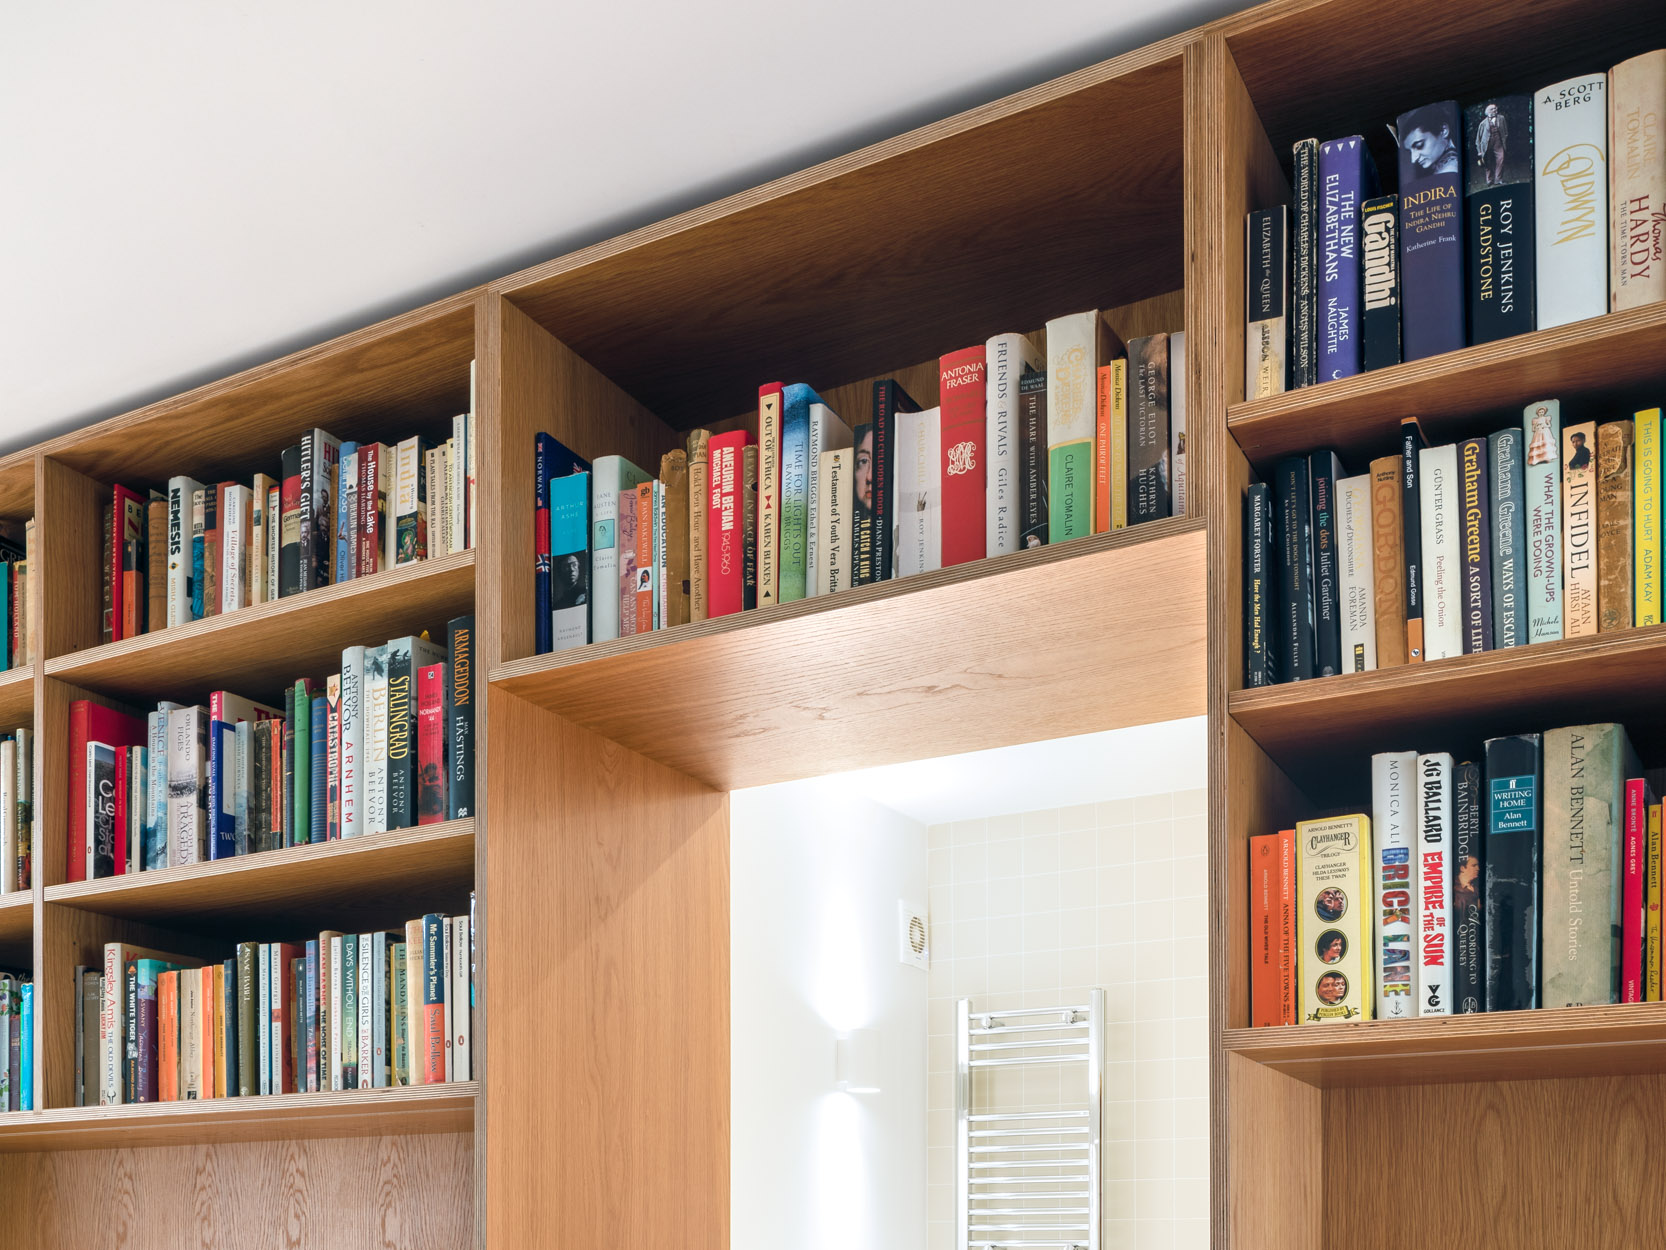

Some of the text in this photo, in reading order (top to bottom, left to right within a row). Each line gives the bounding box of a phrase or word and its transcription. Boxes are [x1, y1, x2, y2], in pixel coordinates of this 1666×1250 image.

[1541, 81, 1604, 105] A. SCOTT
[1555, 93, 1592, 111] BERG
[1626, 106, 1641, 180] TOMALIN
[1643, 112, 1657, 167] CLAIRE
[1325, 173, 1340, 282] ELIZABETHANS
[1340, 191, 1354, 258] THE NEW
[1364, 201, 1394, 213] LOUIS FISCHER
[1403, 185, 1457, 209] INDIRA
[1405, 211, 1456, 229] INDIRA NEHRU
[1416, 221, 1446, 233] GANDHI
[1541, 143, 1605, 247] GOLDWYN
[1364, 212, 1397, 312] Gandhi
[1406, 234, 1456, 254] Katherine Frank
[1480, 203, 1493, 301] GLADSTONE
[1497, 199, 1513, 313] ROY JENKINS
[1629, 194, 1650, 279] HARDY
[1650, 202, 1666, 261] Thomas
[1299, 300, 1308, 368] ANGUS WILSON
[1327, 297, 1338, 355] NAUGHTIE
[1339, 306, 1349, 341] JAMES
[941, 362, 984, 381] ANTONIA
[946, 374, 979, 390] FRASER
[1021, 377, 1045, 385] EDMUND
[1114, 387, 1122, 410] Dickens
[1148, 361, 1156, 446] GEORGE ELIOT
[765, 416, 774, 437] OUT
[765, 439, 774, 455] OF
[300, 435, 312, 519] HITLER'S GIFT
[399, 444, 416, 505] India
[712, 449, 722, 509] MICHAEL FOOT
[764, 454, 774, 491] AFRICA
[809, 420, 819, 505] RAYMOND BRIGGS
[1064, 454, 1074, 536] CLAIRE TOMALIN
[1138, 468, 1147, 515] HUGHES
[1149, 467, 1157, 513] KATHRYN
[1498, 434, 1515, 557] Graham Greene
[170, 487, 182, 556] NEMESIS
[783, 463, 793, 551] RAYMOND BRIGGS
[792, 441, 804, 567] TIME FOR LIGHTS OUT
[997, 467, 1008, 548] Giles Radice
[1253, 495, 1261, 573] MARGARET FORSTER
[1316, 477, 1330, 549] joining the dots
[1433, 468, 1444, 545] GÜNTER GRASS
[1464, 442, 1481, 563] Graham Greene
[1569, 482, 1589, 579] INFIDEL
[763, 513, 772, 585] KAREN BLIXEN
[875, 519, 884, 582] DIANA PRESTON
[1375, 483, 1398, 619] GORDON
[1533, 505, 1543, 577] WERE DOING
[1545, 472, 1556, 603] WHAT THE GROWN-UPS
[1320, 551, 1332, 620] Juliet Gardiner
[1348, 586, 1359, 630] FOREMAN
[1358, 587, 1368, 628] AMANDA
[1436, 555, 1446, 627] Peeling the Onion
[1581, 589, 1591, 624] AYAAN
[1644, 549, 1653, 602] ADAM KAY
[1570, 583, 1580, 635] HIRSI ALI
[342, 664, 352, 734] BEEVOR
[350, 673, 359, 720] ANTONY
[454, 629, 470, 707] ARMAGEDDON
[177, 726, 185, 752] FIGES
[184, 713, 192, 762] ORLANDO
[371, 686, 387, 763] BERLIN
[389, 675, 410, 759] STALINGRAD
[419, 706, 441, 716] NORMANDY
[455, 716, 465, 782] HASTINGS
[344, 742, 354, 823] ARNHEM
[368, 771, 376, 825] BEEVOR
[377, 767, 385, 825] ANTONY
[398, 769, 406, 814] ANTONY
[1390, 760, 1400, 844] MONICA ALI
[1422, 759, 1443, 843] JG BALLARD
[1494, 790, 1532, 800] WRITING
[1500, 799, 1526, 808] HOME
[1569, 733, 1585, 865] ALAN BENNETT
[1310, 831, 1351, 850] CLAYHANGER
[1457, 782, 1470, 863] BAINBRIDGE
[1469, 805, 1479, 837] BERYL
[1498, 820, 1527, 829] Bennett
[1504, 812, 1522, 820] Alan
[1382, 847, 1411, 927] BRICK
[1651, 831, 1660, 889] Alan Bennett
[1423, 851, 1446, 967] EMPIRE OF THE SUN
[1568, 869, 1584, 961] Untold Stories
[428, 923, 438, 1001] Mr Sammler's Planet
[1382, 934, 1411, 998] LANE
[1457, 924, 1469, 967] QUEENEY
[1467, 904, 1480, 984] ACCORDING TO
[105, 948, 117, 1030] Kingsley Amis
[345, 942, 354, 1037] DAYS WITHOUT END
[361, 943, 371, 1026] SILENCE GIRLS
[361, 1035, 369, 1075] BARKER
[430, 1008, 441, 1073] Saul Bellow
